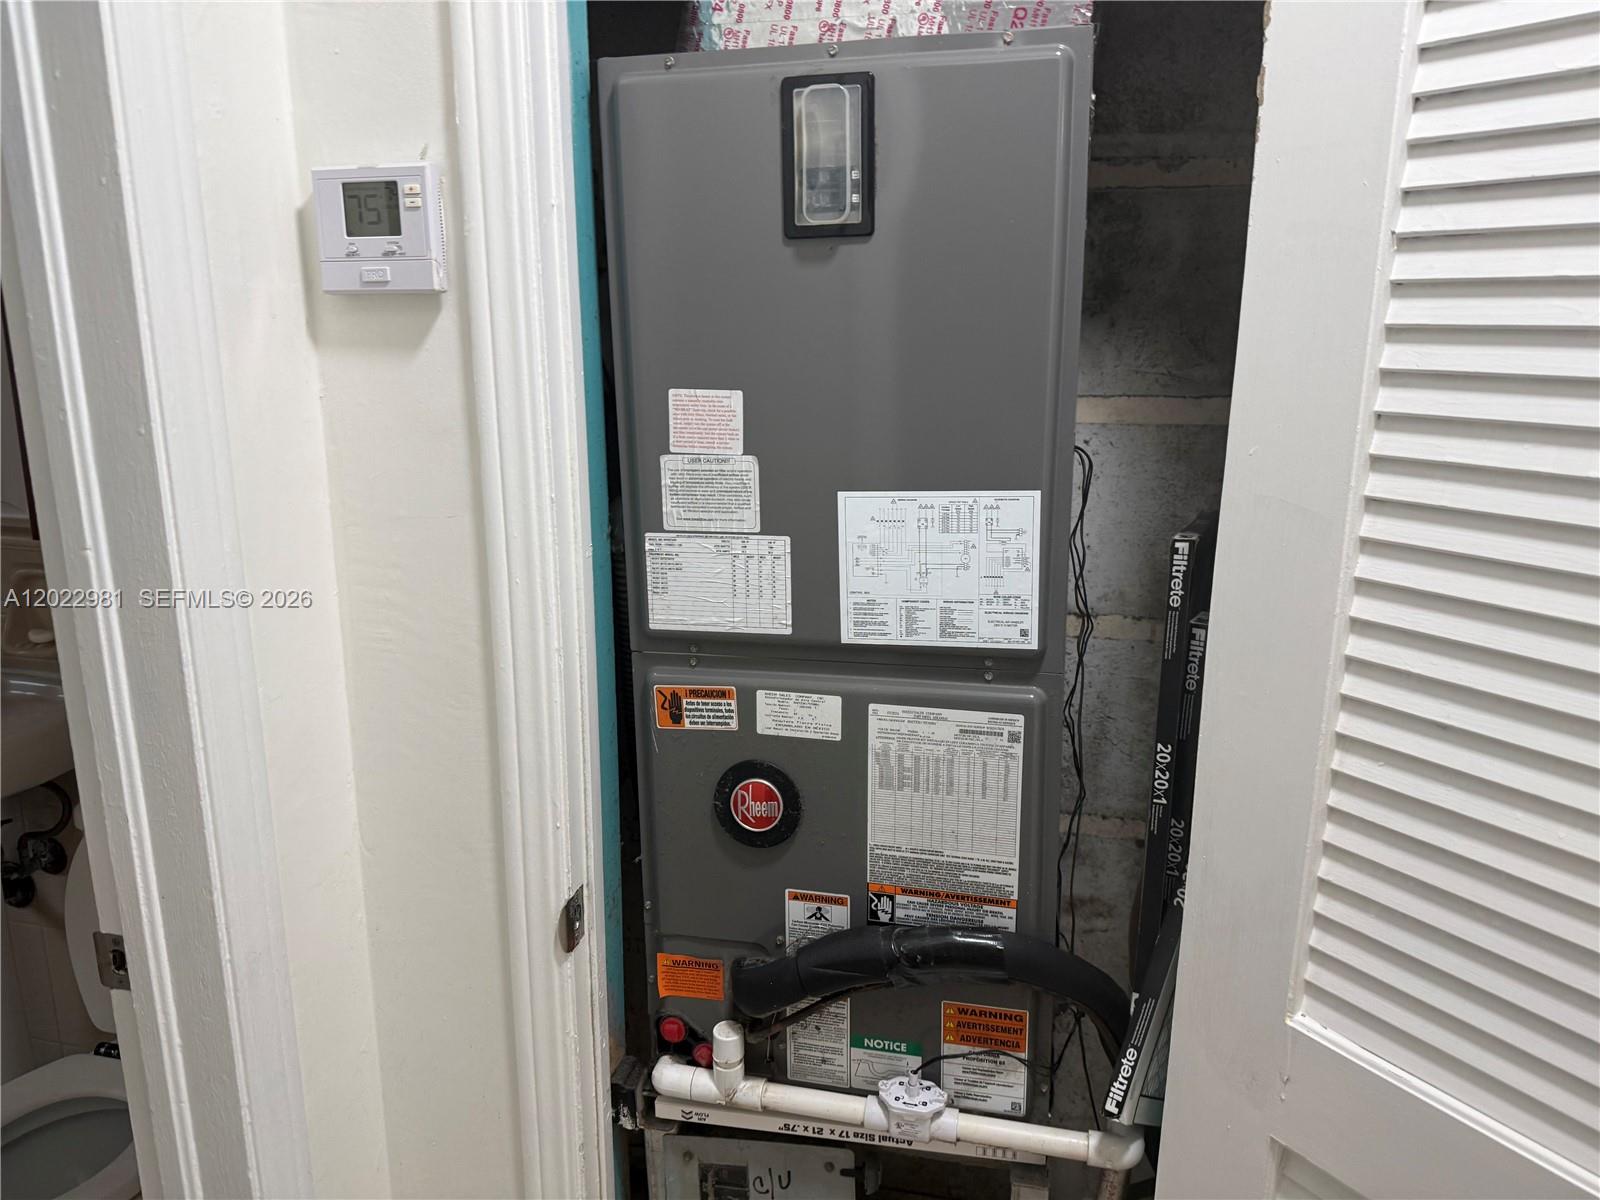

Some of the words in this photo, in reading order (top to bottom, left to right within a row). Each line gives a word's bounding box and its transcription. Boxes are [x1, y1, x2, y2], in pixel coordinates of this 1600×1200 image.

[347, 194, 382, 226] 75
[1169, 541, 1190, 609] Filtrete
[1185, 627, 1207, 692] Filtrete
[1153, 743, 1172, 805] 20x20x1
[737, 784, 778, 824] Rheem
[1166, 818, 1185, 876] 20x20x1
[800, 893, 844, 905] WARNING
[672, 959, 719, 969] WARNING
[957, 1007, 1024, 1023] WARNING
[956, 1020, 1025, 1036] AVERTISSEMENT
[863, 1038, 907, 1052] NOTICE
[960, 1034, 1021, 1049] ADVERTENCIA
[1104, 1047, 1138, 1115] Filtrete
[812, 1126, 824, 1135] 21
[838, 1130, 851, 1139] 17
[853, 1131, 876, 1142] Size
